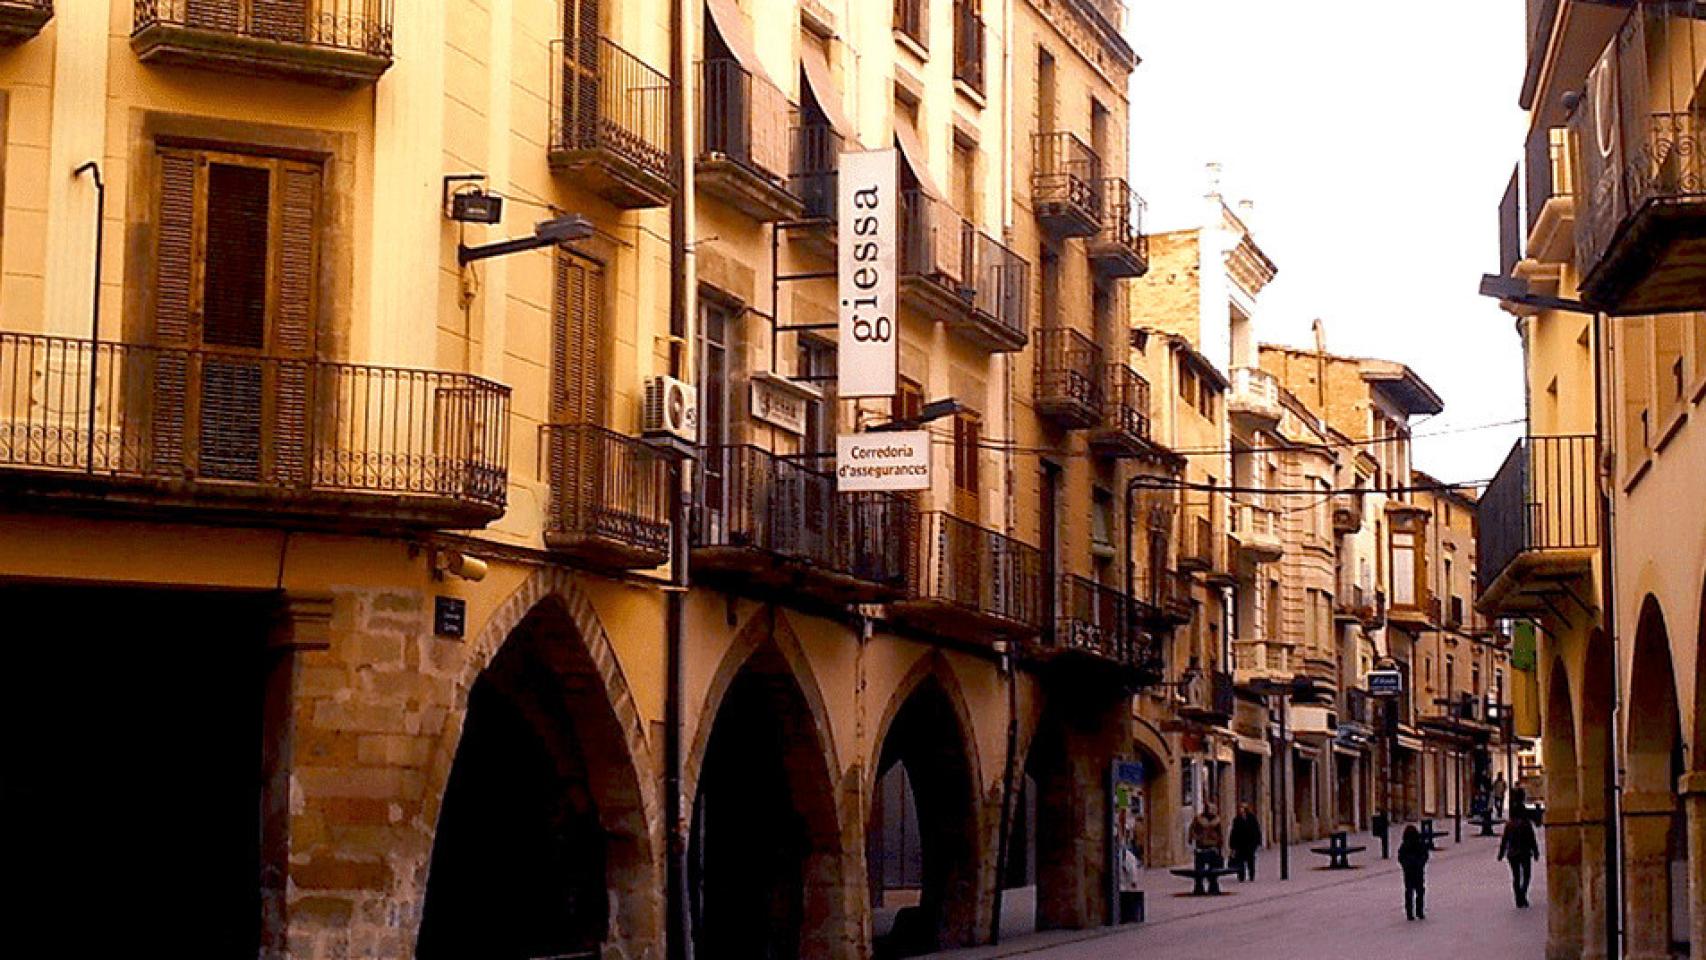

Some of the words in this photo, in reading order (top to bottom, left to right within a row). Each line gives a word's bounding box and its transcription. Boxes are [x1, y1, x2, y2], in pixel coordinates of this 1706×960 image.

[842, 185, 891, 342] giessa
[851, 445, 914, 459] Corredoria
[839, 464, 928, 479] d'assegurances
